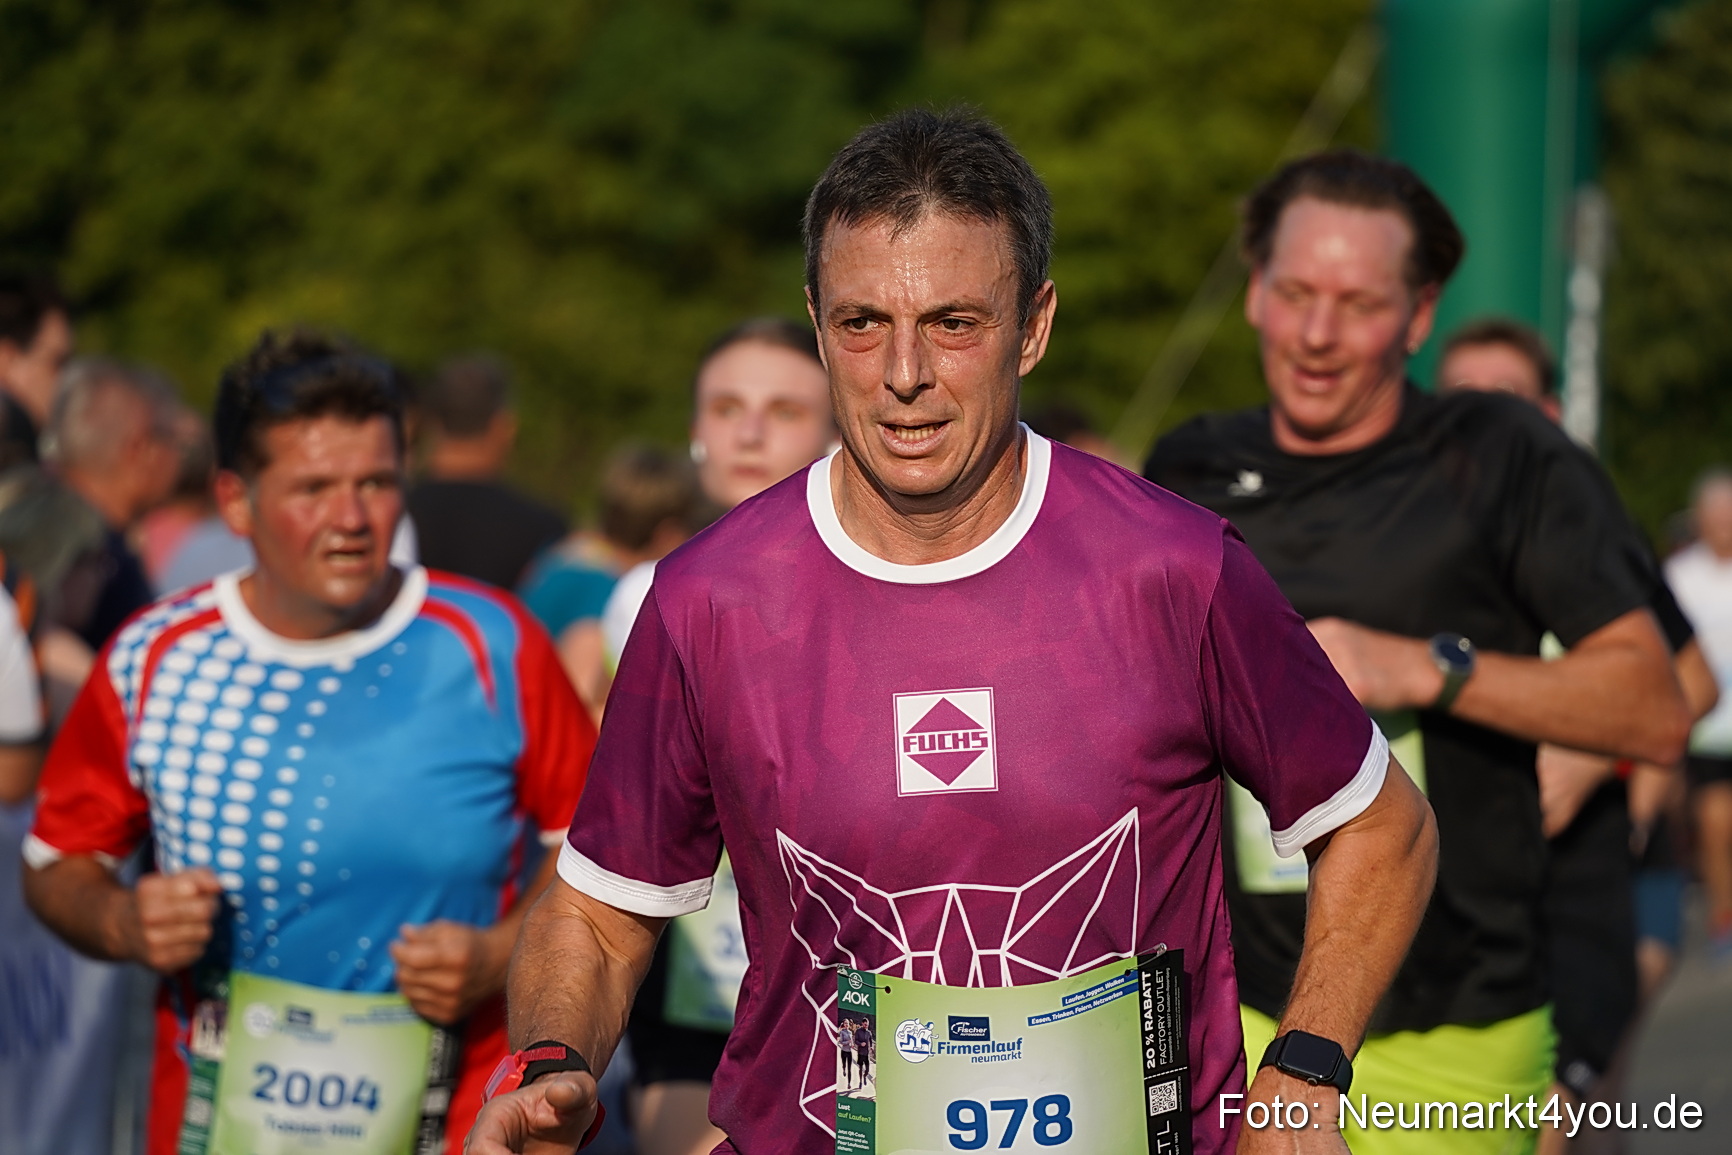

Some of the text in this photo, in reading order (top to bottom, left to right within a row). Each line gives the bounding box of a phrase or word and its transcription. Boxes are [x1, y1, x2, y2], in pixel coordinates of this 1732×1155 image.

[903, 731, 988, 753] FUCHS
[842, 990, 870, 1007] AOK
[1065, 977, 1125, 1004] Laufen, Joggen, Walken
[1031, 991, 1123, 1024] Essen, Trinken, Feiern, Netzwerken
[1156, 969, 1168, 1066] FACTORY OUTLET
[953, 1021, 988, 1034] Fischer
[1142, 971, 1156, 1070] 20 % RABATT
[937, 1037, 1023, 1055] Firmenlauf
[971, 1051, 1022, 1063] neumarkt
[254, 1063, 379, 1112] 2004
[838, 1103, 851, 1111] Lust
[849, 1114, 871, 1123] Laufen?
[946, 1094, 1073, 1150] 978
[848, 1131, 866, 1139] QR-Code
[1156, 1120, 1172, 1155] TL
